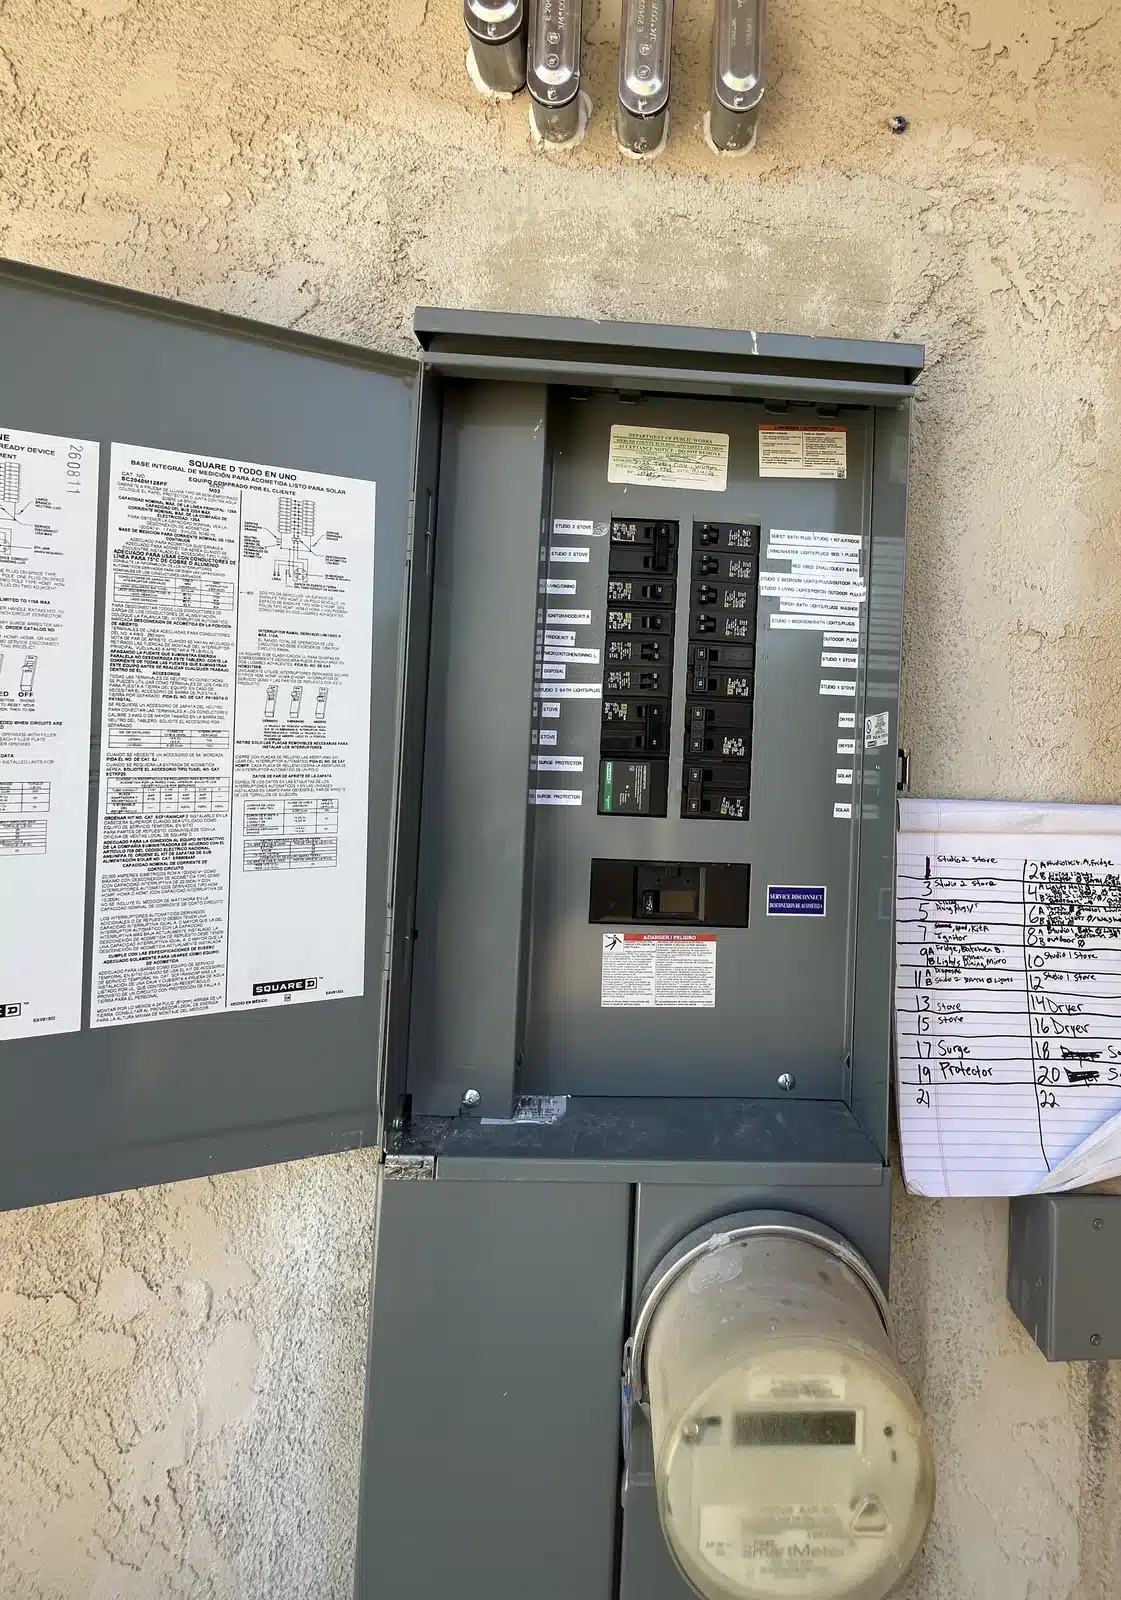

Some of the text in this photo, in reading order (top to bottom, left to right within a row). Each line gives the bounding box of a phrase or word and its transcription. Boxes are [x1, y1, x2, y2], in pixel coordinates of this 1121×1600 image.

[27, 446, 55, 456] DEVICE
[152, 463, 186, 472] INTEGRAL
[252, 477, 288, 487] ACOMETIDA
[189, 460, 226, 471] SQUARE
[238, 467, 262, 476] TODO
[1029, 863, 1039, 879] 2
[922, 881, 932, 896] 3
[1028, 885, 1038, 901] 4
[919, 902, 929, 920] 5
[1029, 905, 1039, 923] 6
[1027, 928, 1038, 946] 8
[1028, 954, 1044, 968] 10
[256, 982, 302, 993] SQUARE
[1030, 974, 1044, 991] 12
[916, 995, 930, 1012] 13
[1031, 995, 1083, 1016] 14 Dryer
[918, 1015, 930, 1034] 15
[1035, 1017, 1090, 1037] 16 Dryer
[916, 1040, 970, 1059] 17 Surge
[1035, 1041, 1050, 1059] 18
[918, 1061, 993, 1084] 19 Protector
[1038, 1065, 1060, 1084] 20
[916, 1088, 930, 1108] 21
[1040, 1089, 1060, 1107] 22
